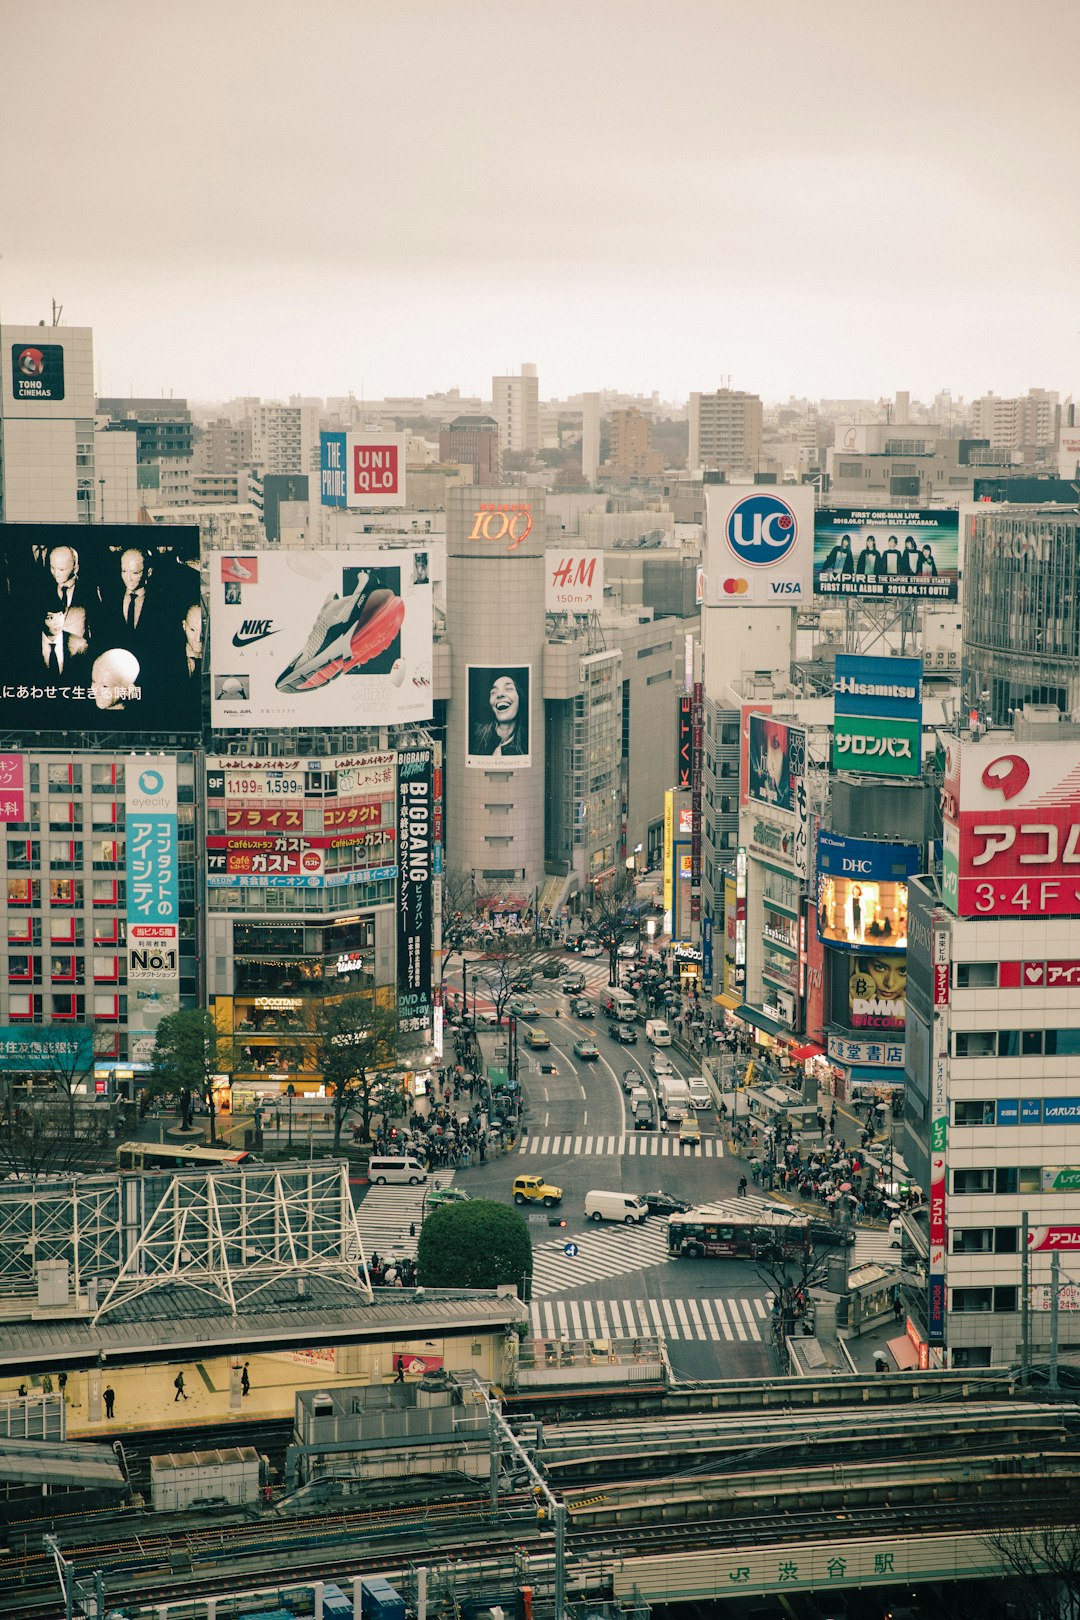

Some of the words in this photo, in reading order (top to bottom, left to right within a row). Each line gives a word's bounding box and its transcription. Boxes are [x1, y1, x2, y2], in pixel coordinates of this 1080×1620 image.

[19, 381, 42, 389] TOHO
[327, 442, 340, 468] THE
[359, 452, 390, 468] UNI
[322, 470, 345, 496] PRIME
[359, 472, 393, 490] QLO
[467, 511, 532, 550] 109
[552, 558, 596, 588] H&M
[770, 582, 802, 594] VISA
[842, 584, 858, 593] FULL
[858, 584, 884, 594] ALBUM
[556, 594, 582, 603] 150m
[240, 620, 274, 634] NIKE
[0, 685, 142, 700] にあわせて生きる時間
[833, 676, 916, 698] Hisamitsu
[836, 734, 912, 758] サロンパス
[334, 754, 394, 768] しゃぶしゃぶバイキング
[398, 752, 430, 764] BIGBANG
[790, 745, 805, 766] GO
[219, 760, 300, 770] しゃぶしゃぶバイキング
[0, 773, 12, 784] ク
[208, 778, 223, 788] 9F
[358, 768, 392, 786] しゃぶ葉
[132, 798, 170, 808] eyecity
[228, 811, 300, 826] プライス
[324, 806, 379, 824] コンタクト
[365, 832, 391, 846] ガスト
[410, 782, 428, 882] BIGBANG
[275, 838, 310, 851] ガスト
[208, 856, 226, 867] 7F
[230, 856, 250, 864] Café
[252, 854, 296, 872] ガスト
[842, 858, 872, 873] DHC
[132, 823, 153, 916] アイシティ
[158, 823, 172, 916] コンタクトの
[349, 870, 396, 882] 英会話イーオン
[240, 876, 304, 886] 英会話イーオン
[137, 928, 172, 936] 当ビル5階
[130, 950, 176, 970] No.1
[938, 974, 946, 1004] アイフル
[400, 994, 418, 1006] DVD
[420, 992, 427, 1003] &
[400, 1004, 430, 1017] Blu-ray
[853, 998, 905, 1016] DMM
[400, 1016, 430, 1033] 発売中
[852, 1016, 905, 1028] Bitcoin
[830, 1040, 903, 1062] 大盛堂書店
[934, 1122, 944, 1148] レイク
[933, 1198, 942, 1224] アコム
[932, 1285, 940, 1320] PROMISE
[730, 1568, 750, 1580] JR
[778, 1553, 894, 1582] 渋谷駅
